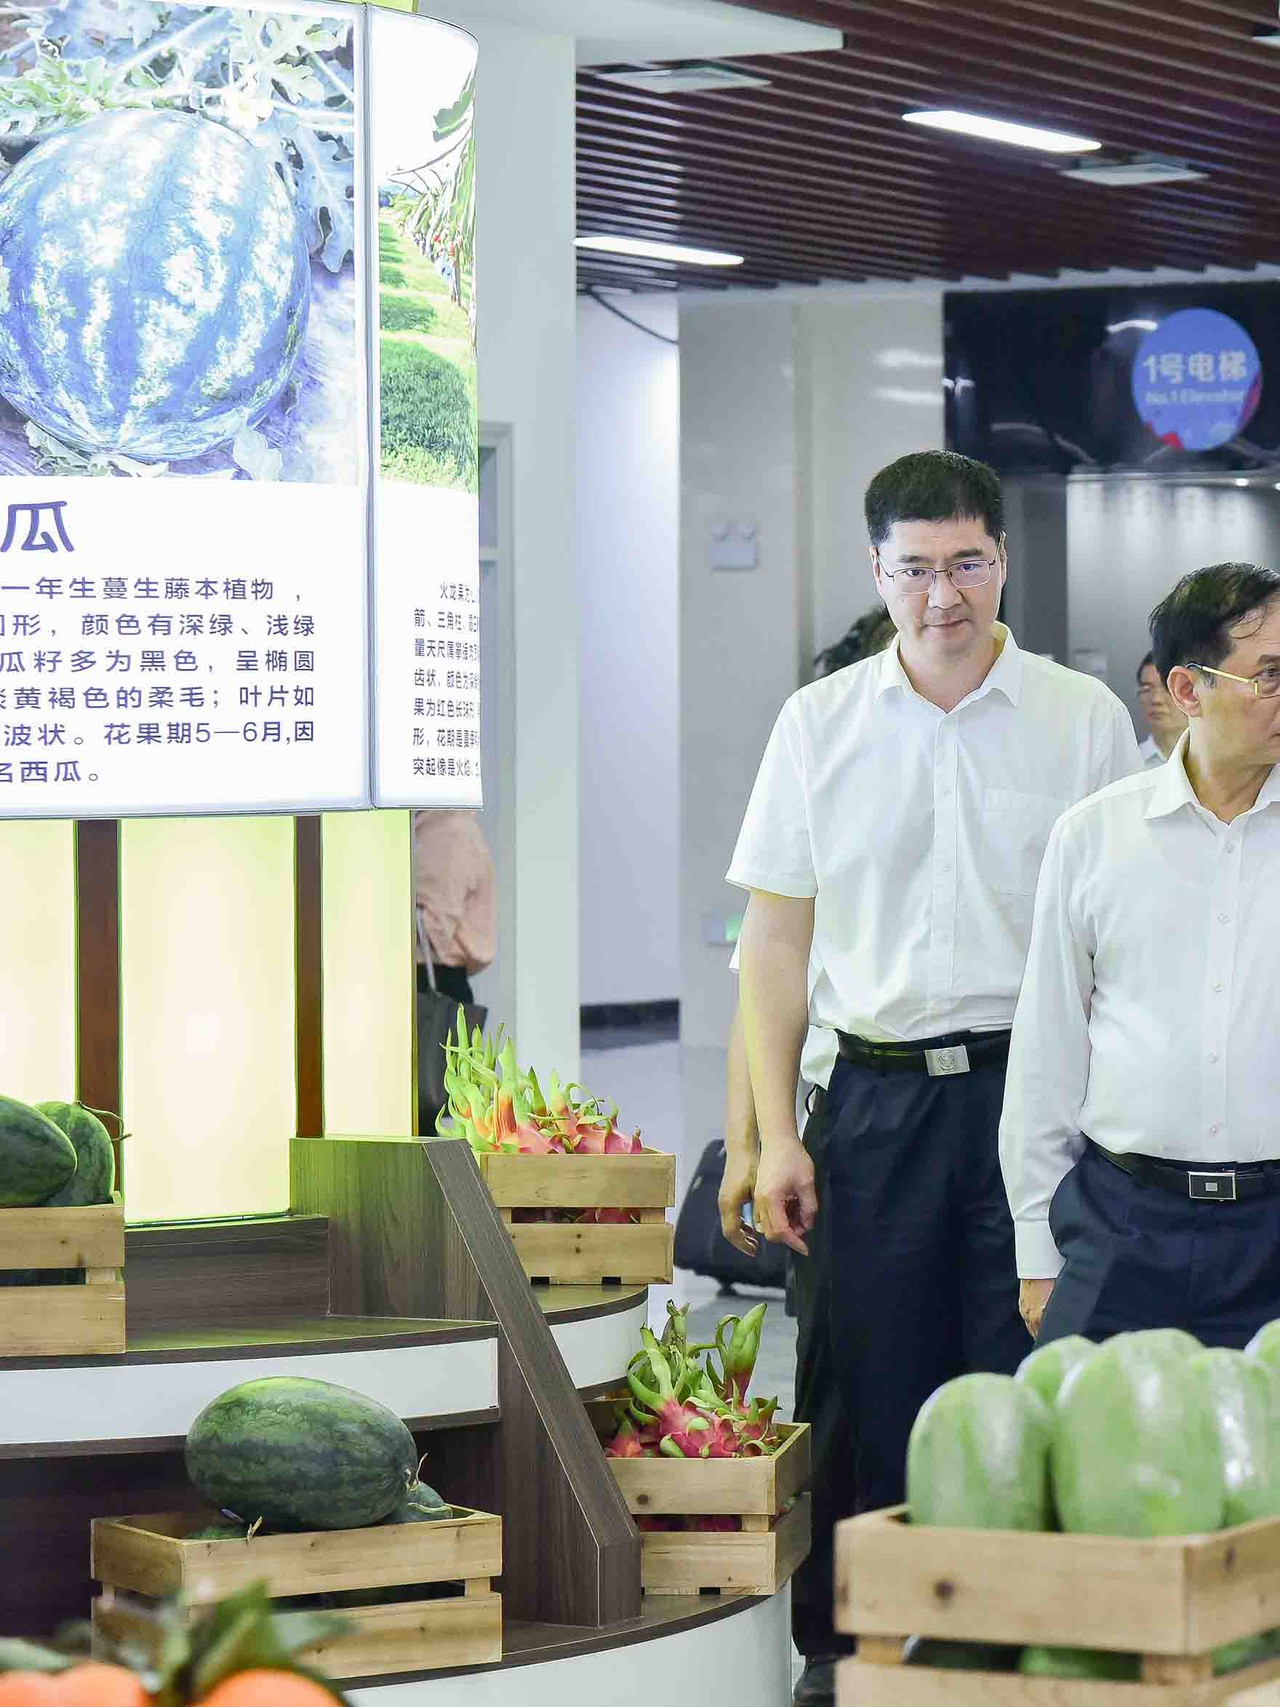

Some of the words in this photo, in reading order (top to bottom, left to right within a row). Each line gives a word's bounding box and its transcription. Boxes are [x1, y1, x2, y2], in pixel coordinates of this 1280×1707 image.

[1143, 351, 1248, 384] 1号电梯
[0, 500, 75, 553] 瓜
[0, 613, 315, 637] 形，颜色有深绿、浅绿
[0, 685, 314, 710] 黄褐色的柔毛；叶片如
